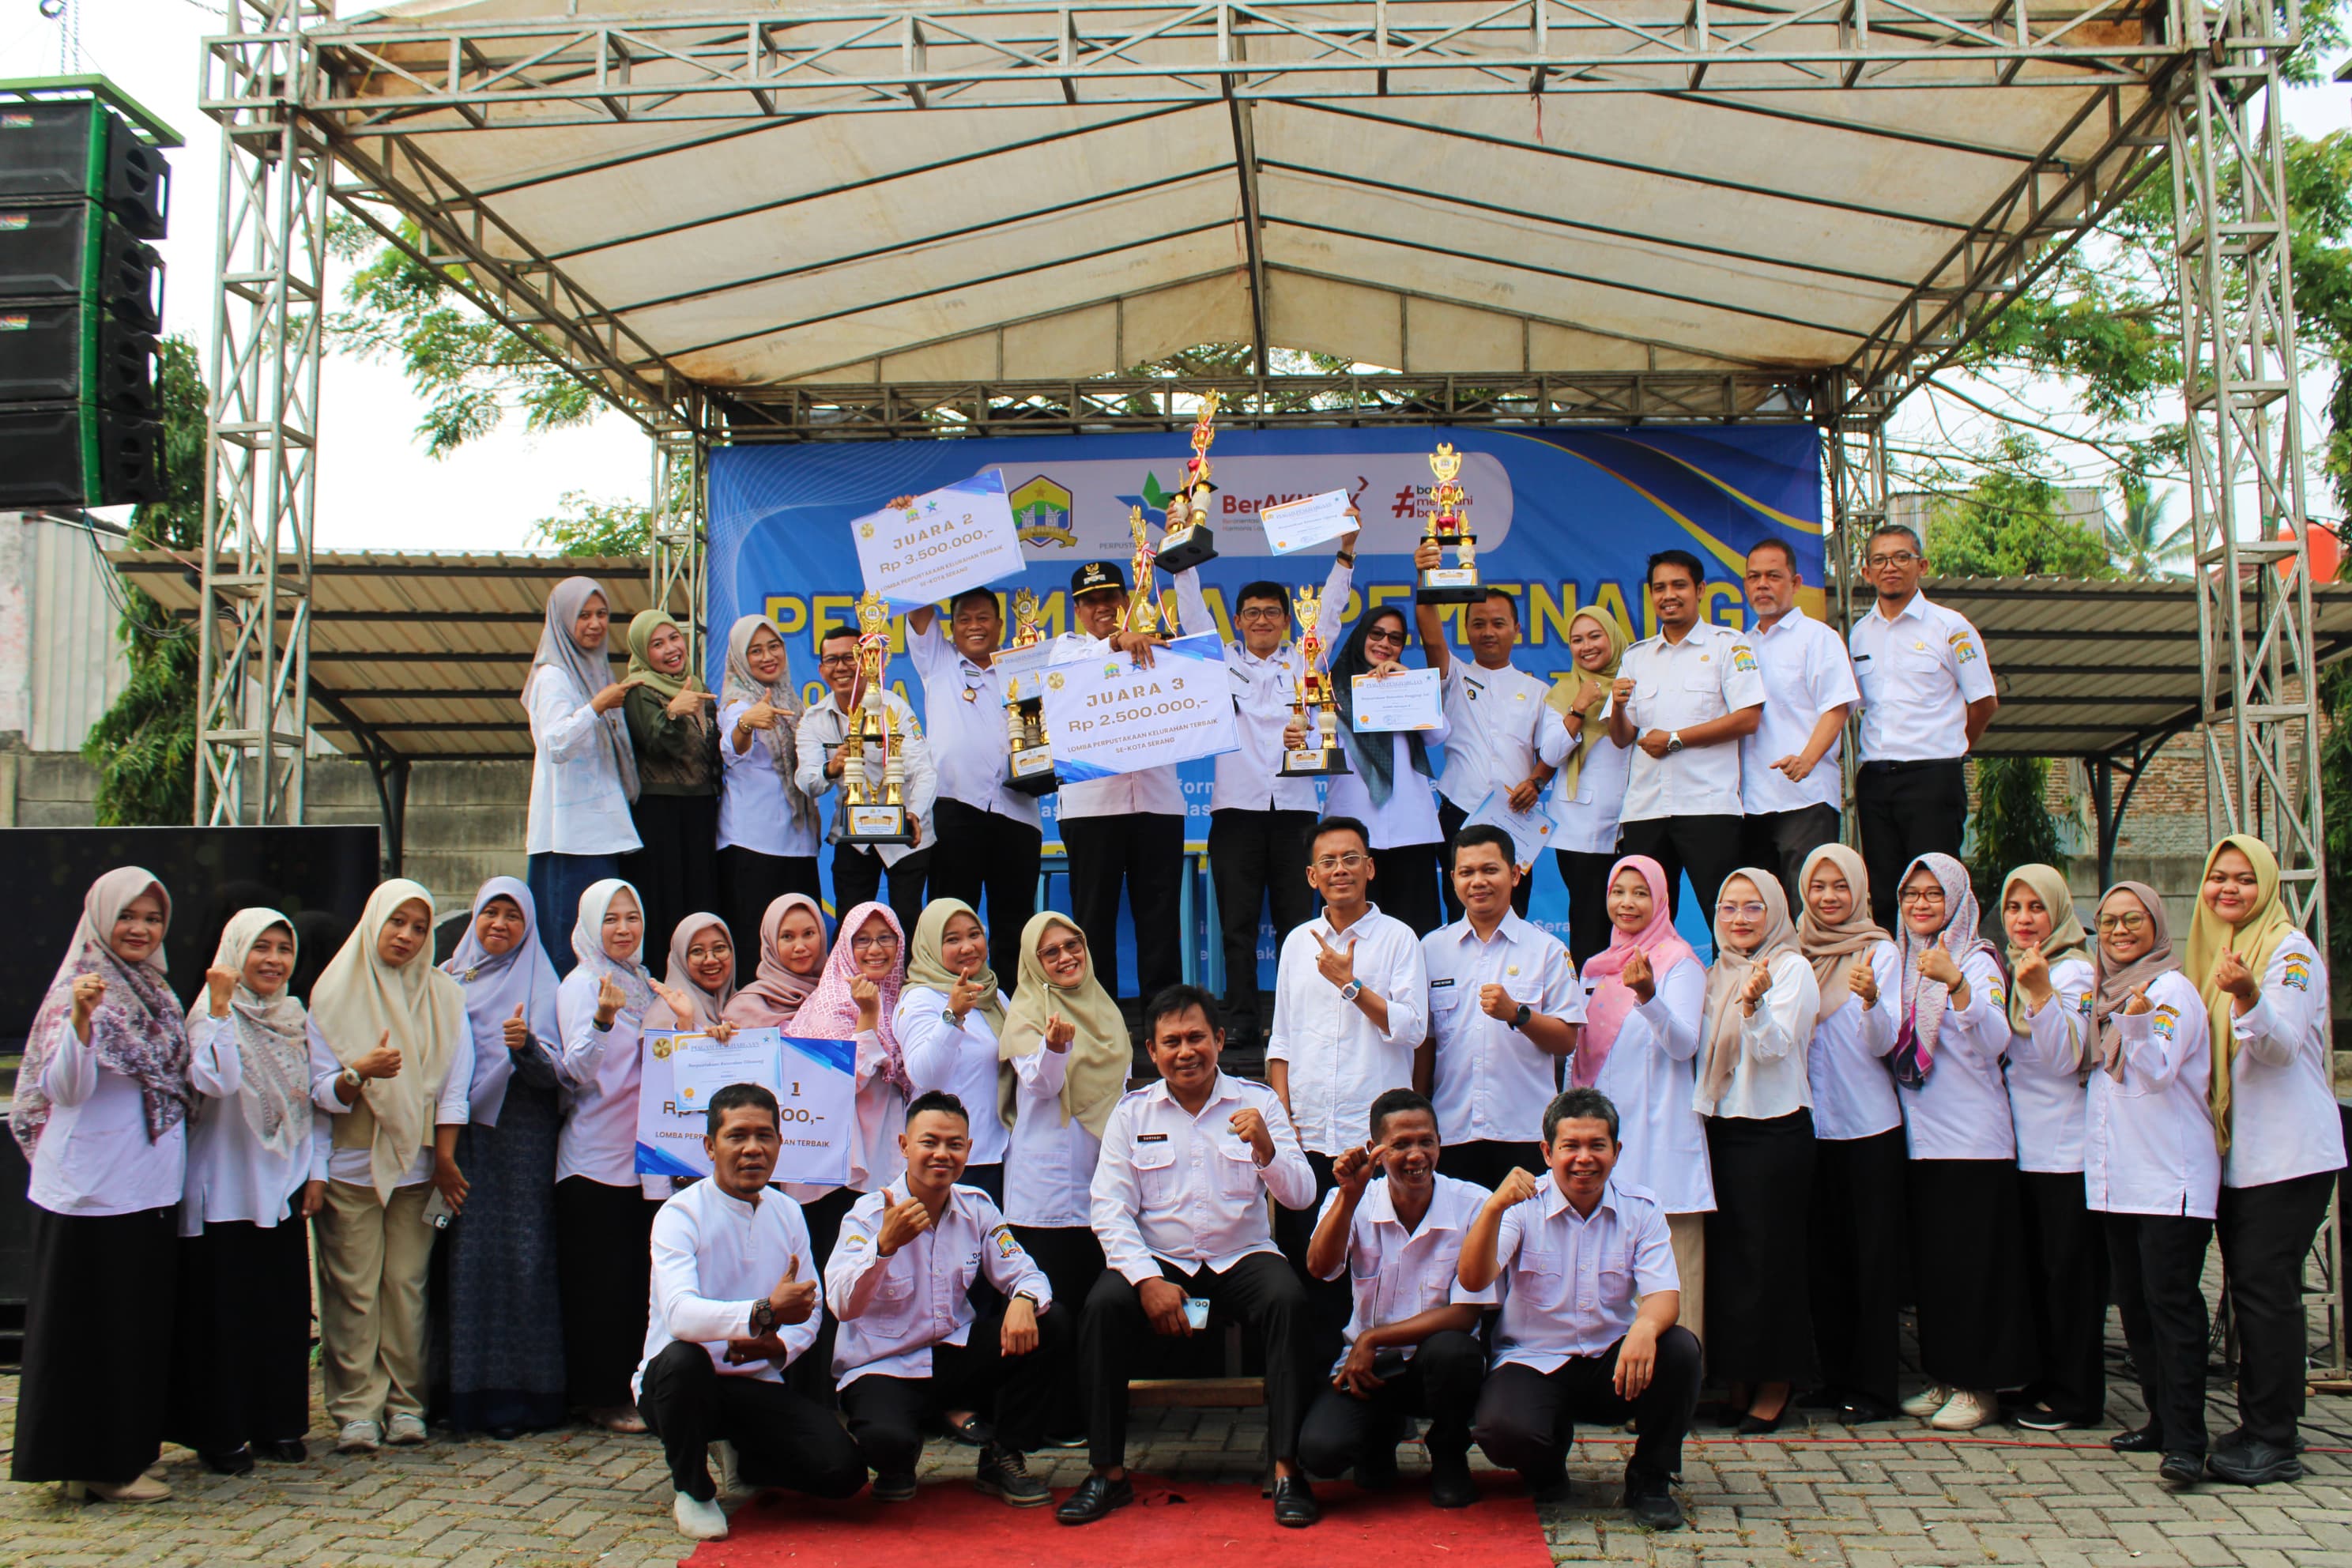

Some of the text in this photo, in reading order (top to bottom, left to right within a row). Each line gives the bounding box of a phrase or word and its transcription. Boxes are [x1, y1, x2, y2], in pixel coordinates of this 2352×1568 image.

[893, 513, 973, 549] JUARA 2
[880, 529, 993, 574] Rp 3.500.000,-
[1087, 677, 1185, 707] JUARA 3
[1068, 697, 1208, 733] Rp 2.500.000,-
[1068, 718, 1219, 753] LOMBA PERPUSTAKAAN KELURAHAN TERBAIK
[1115, 737, 1175, 753] SE-KOTA SERANG
[791, 1082, 801, 1096] 1
[797, 1139, 830, 1148] TERBAIK
